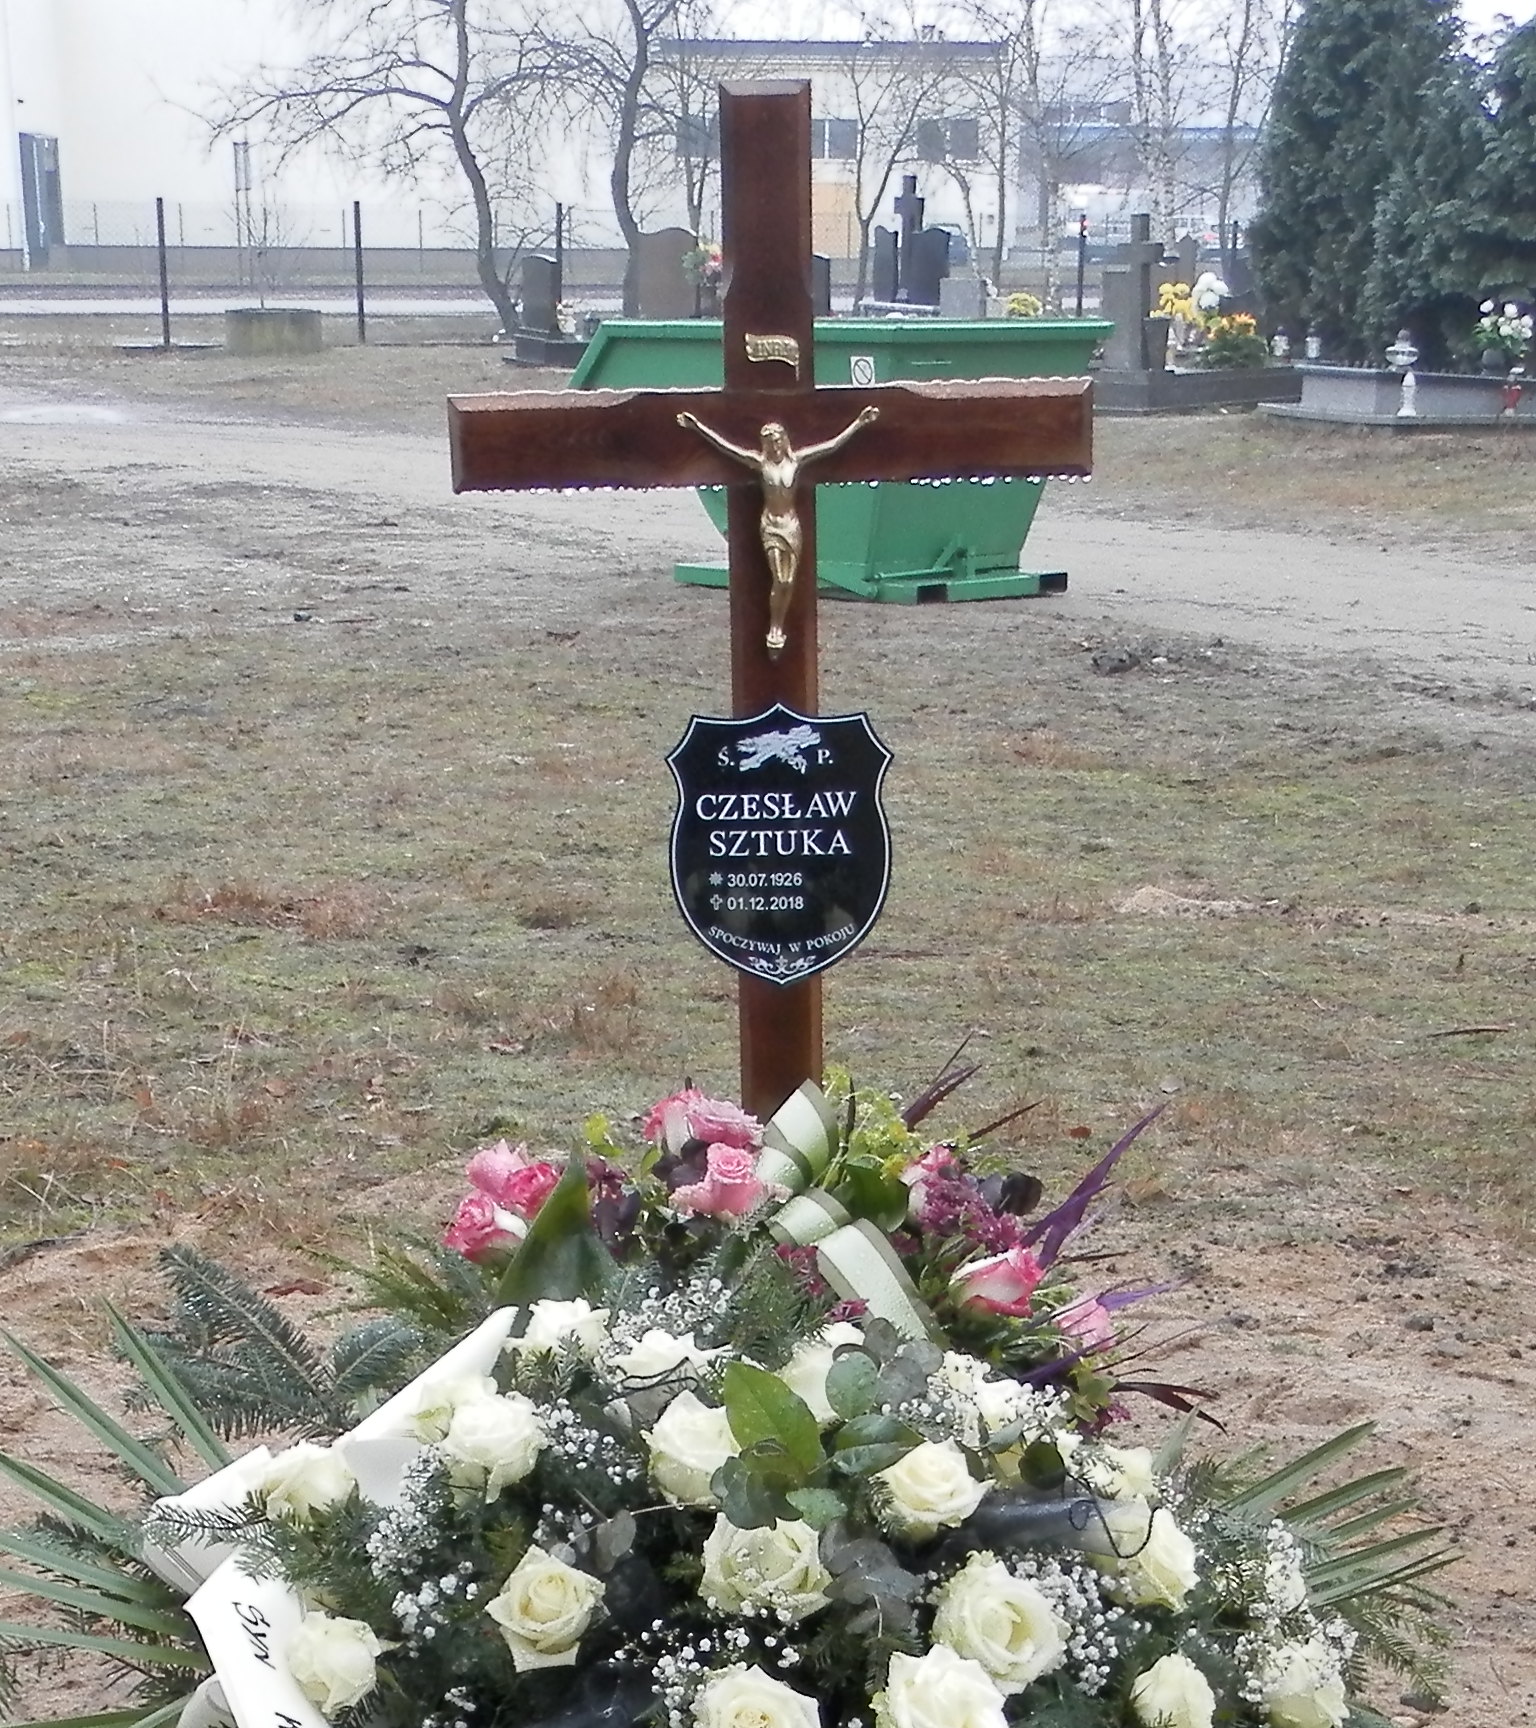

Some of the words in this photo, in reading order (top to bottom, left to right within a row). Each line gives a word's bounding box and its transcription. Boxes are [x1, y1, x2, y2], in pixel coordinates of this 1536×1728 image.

[695, 791, 857, 821] CZESŁAW
[709, 829, 852, 857] SZTUKA
[727, 872, 803, 888] 30.07.1926
[727, 896, 804, 911] 01.12.2018
[708, 926, 782, 955] SPOCZYWAJ
[789, 942, 802, 953] W
[806, 923, 856, 951] POKOJU
[231, 1602, 276, 1671] SYN
